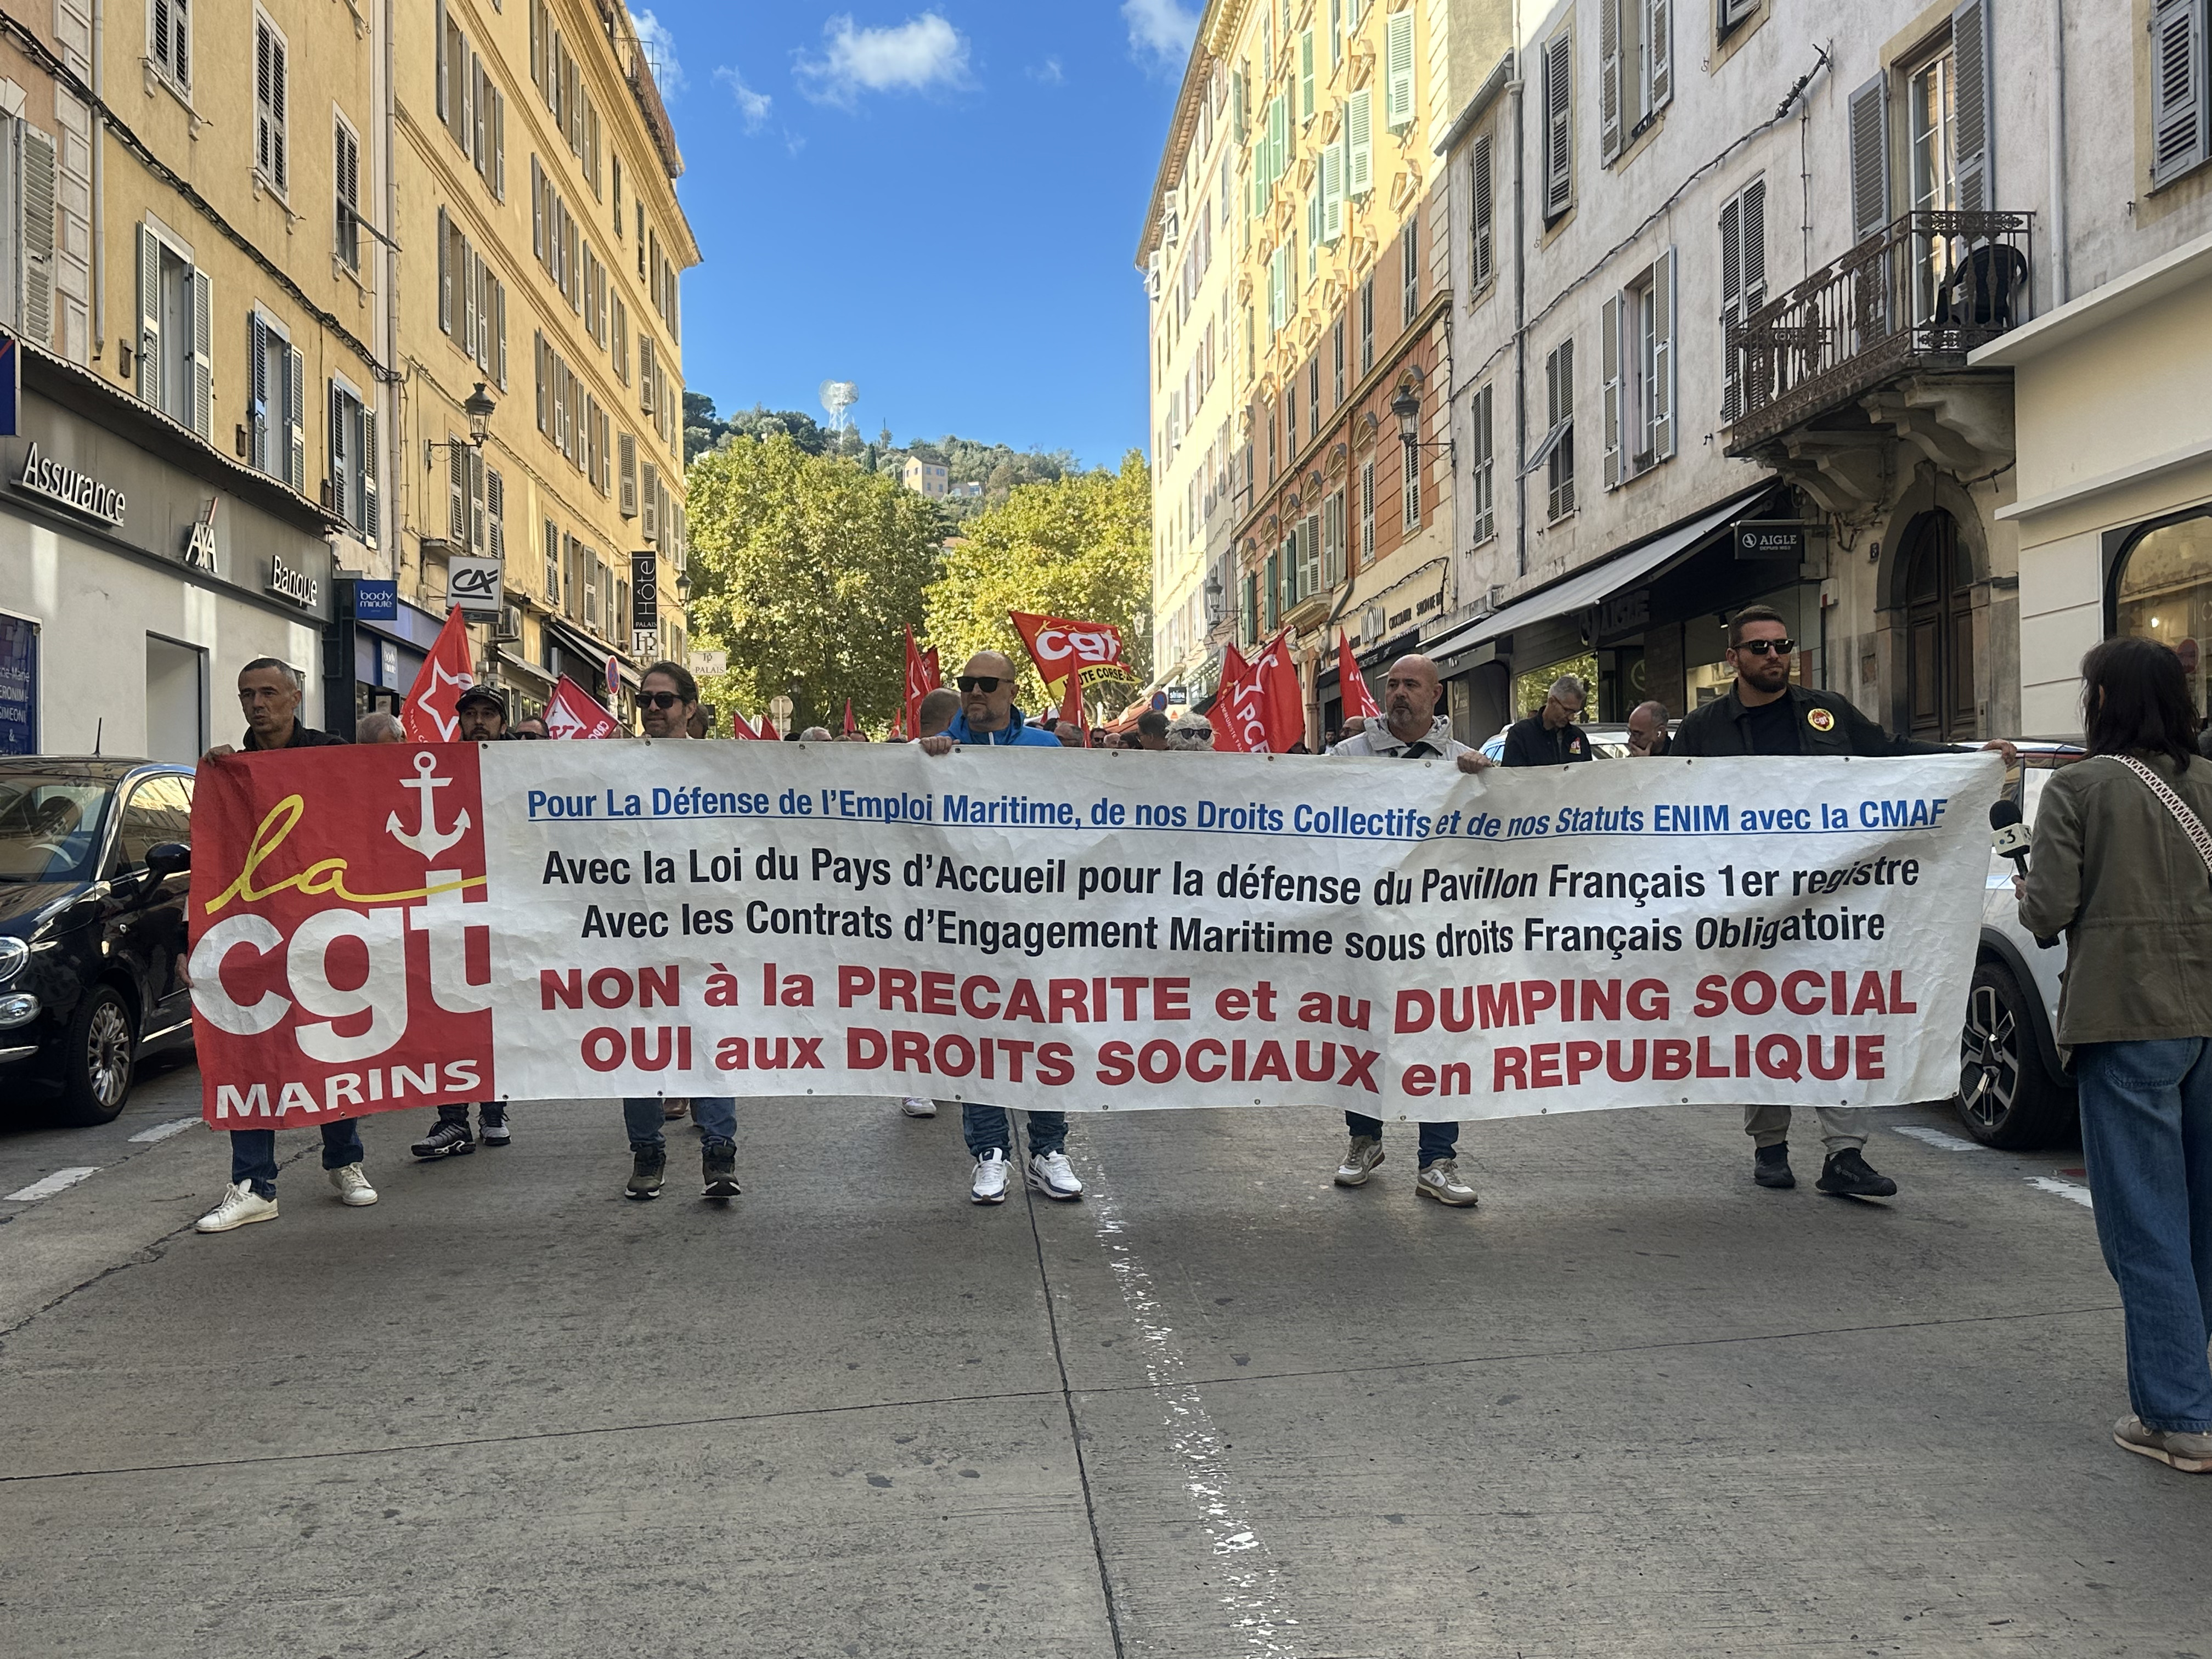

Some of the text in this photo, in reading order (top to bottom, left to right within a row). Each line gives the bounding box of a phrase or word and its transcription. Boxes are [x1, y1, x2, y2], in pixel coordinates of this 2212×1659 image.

[22, 442, 126, 522] Assurance
[185, 522, 218, 573] AXA
[1759, 535, 1797, 545] AIGLE
[273, 555, 317, 606] Banque
[360, 590, 393, 601] body
[632, 556, 656, 616] Hôtel
[1036, 629, 1120, 662] cgt
[9, 729, 16, 743] &
[1220, 702, 1235, 739] OMMUNISTE
[528, 787, 1948, 838] Pour La Défense de l’Emploi Maritime, de nos Droits Collectifs et de nos Statuts ENIM avec la CMAF
[2005, 829, 2016, 844] 3
[543, 847, 1919, 907] Avec la Loi du Pays d’Accueil pour la défense du Pavillon Français 1er registre
[581, 900, 1884, 961] Avec les Contrats d’Engagement Maritime sous droits Français Obligatoire
[188, 869, 493, 1063] cgt
[540, 962, 1917, 1034] NON à la PRECARITE et au DUMPING SOCIAL
[580, 1026, 1886, 1097] OUI aux DROITS SOCIAUX en REPUBLIQUE
[216, 1059, 481, 1119] MARINS
